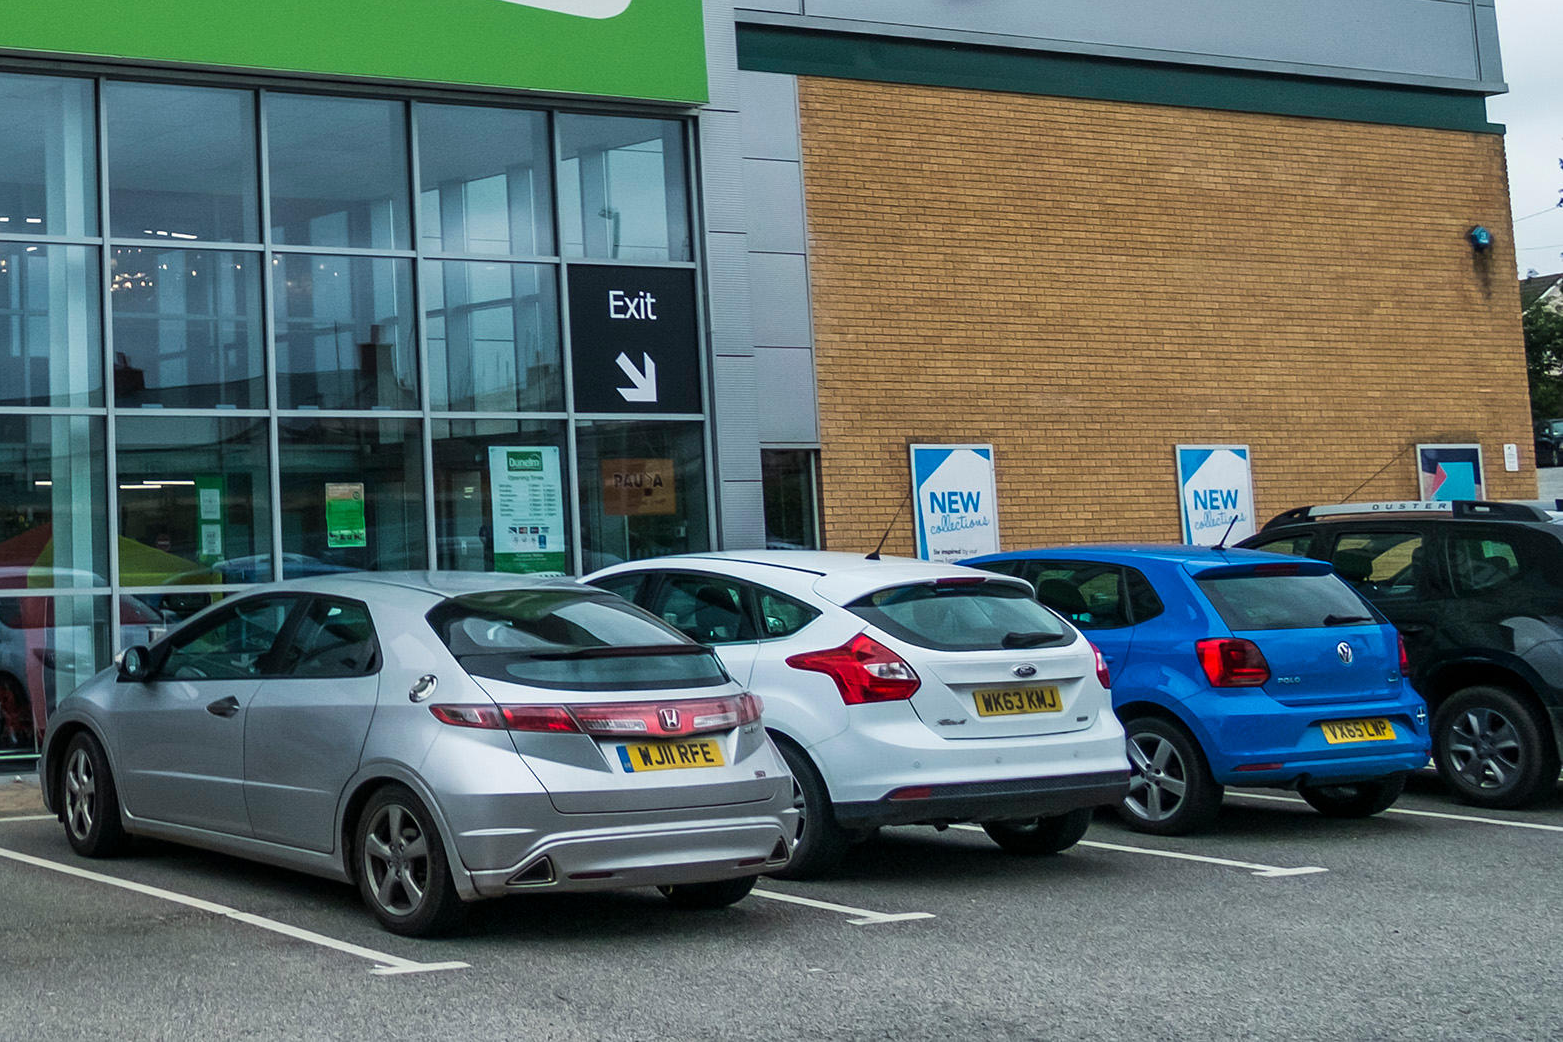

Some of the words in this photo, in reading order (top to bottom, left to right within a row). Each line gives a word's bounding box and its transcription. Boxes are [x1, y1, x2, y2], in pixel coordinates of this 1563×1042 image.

[607, 289, 658, 321] Exit
[929, 491, 981, 514] NEW
[1193, 489, 1239, 510] NEW
[1372, 502, 1447, 511] DUSTER
[930, 514, 990, 535] collections
[1277, 676, 1301, 684] POLO
[982, 690, 1023, 713] WK63
[1026, 687, 1057, 709] KMJ
[1327, 723, 1364, 740] VX65
[1364, 720, 1387, 737] LWP
[637, 745, 676, 766] WJ11
[675, 742, 716, 764] RFE
